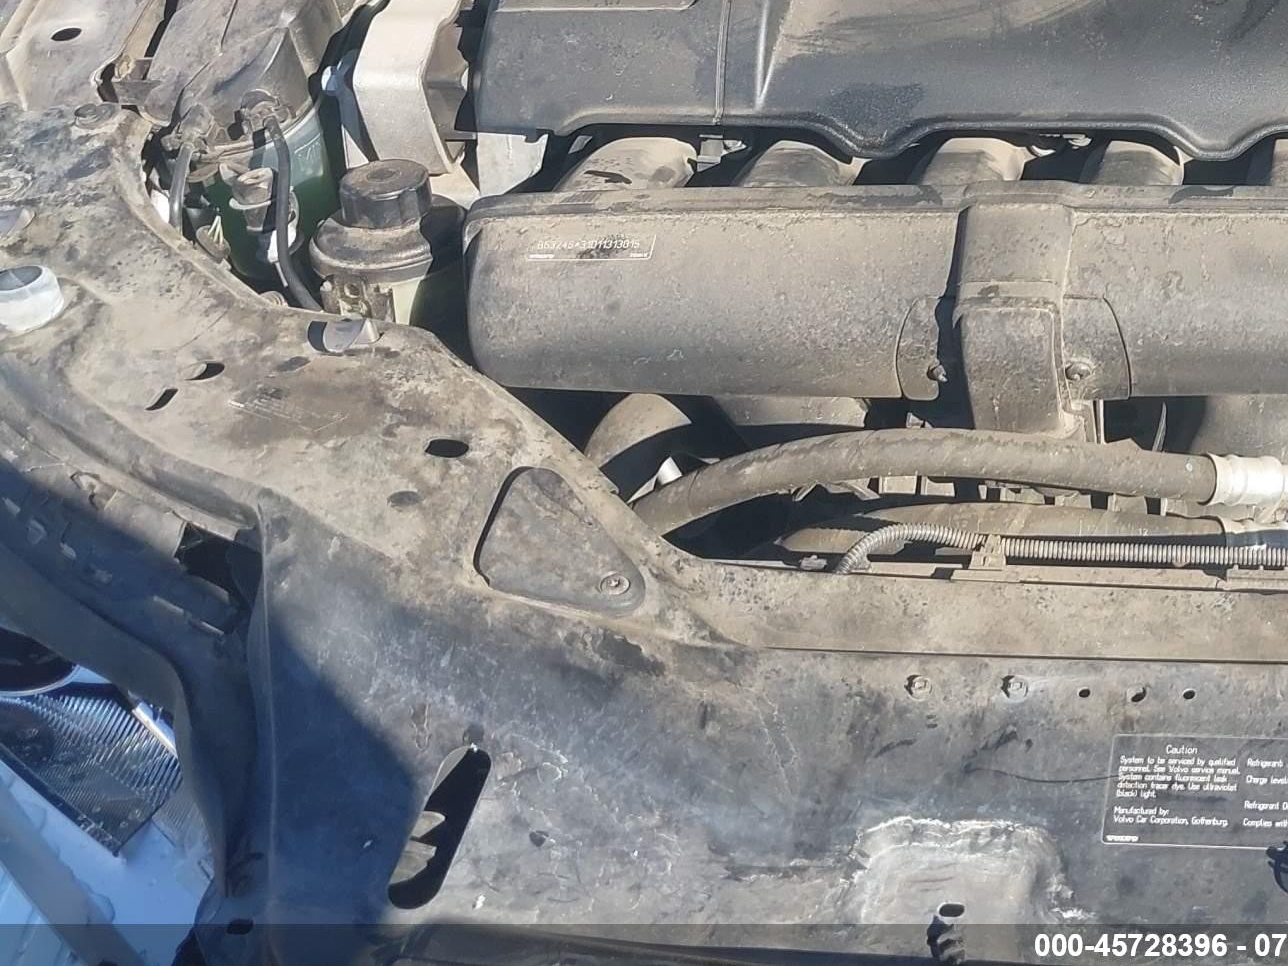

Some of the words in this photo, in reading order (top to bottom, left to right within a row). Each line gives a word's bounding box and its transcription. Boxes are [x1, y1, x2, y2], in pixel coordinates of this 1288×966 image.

[1166, 744, 1198, 754] Caution
[1120, 755, 1144, 765] System
[1147, 756, 1155, 764] to
[1157, 756, 1165, 764] be
[1168, 757, 1195, 765] serviced
[1197, 757, 1205, 766] by
[1153, 765, 1166, 773] See
[1169, 765, 1189, 773] Volvo
[1191, 766, 1214, 774] service
[1118, 772, 1142, 782] System
[1144, 773, 1172, 782] contains
[1175, 774, 1210, 783] fluorescent
[1246, 774, 1268, 785] Charge
[1117, 781, 1147, 790] detection
[1188, 782, 1200, 790] Use
[1202, 782, 1238, 792] ultraviolet
[1113, 806, 1157, 815] Manufactured
[1244, 800, 1279, 811] Refrigerant
[1113, 815, 1134, 824] Volvo
[1136, 815, 1147, 824] Car
[1242, 817, 1272, 828] Complies
